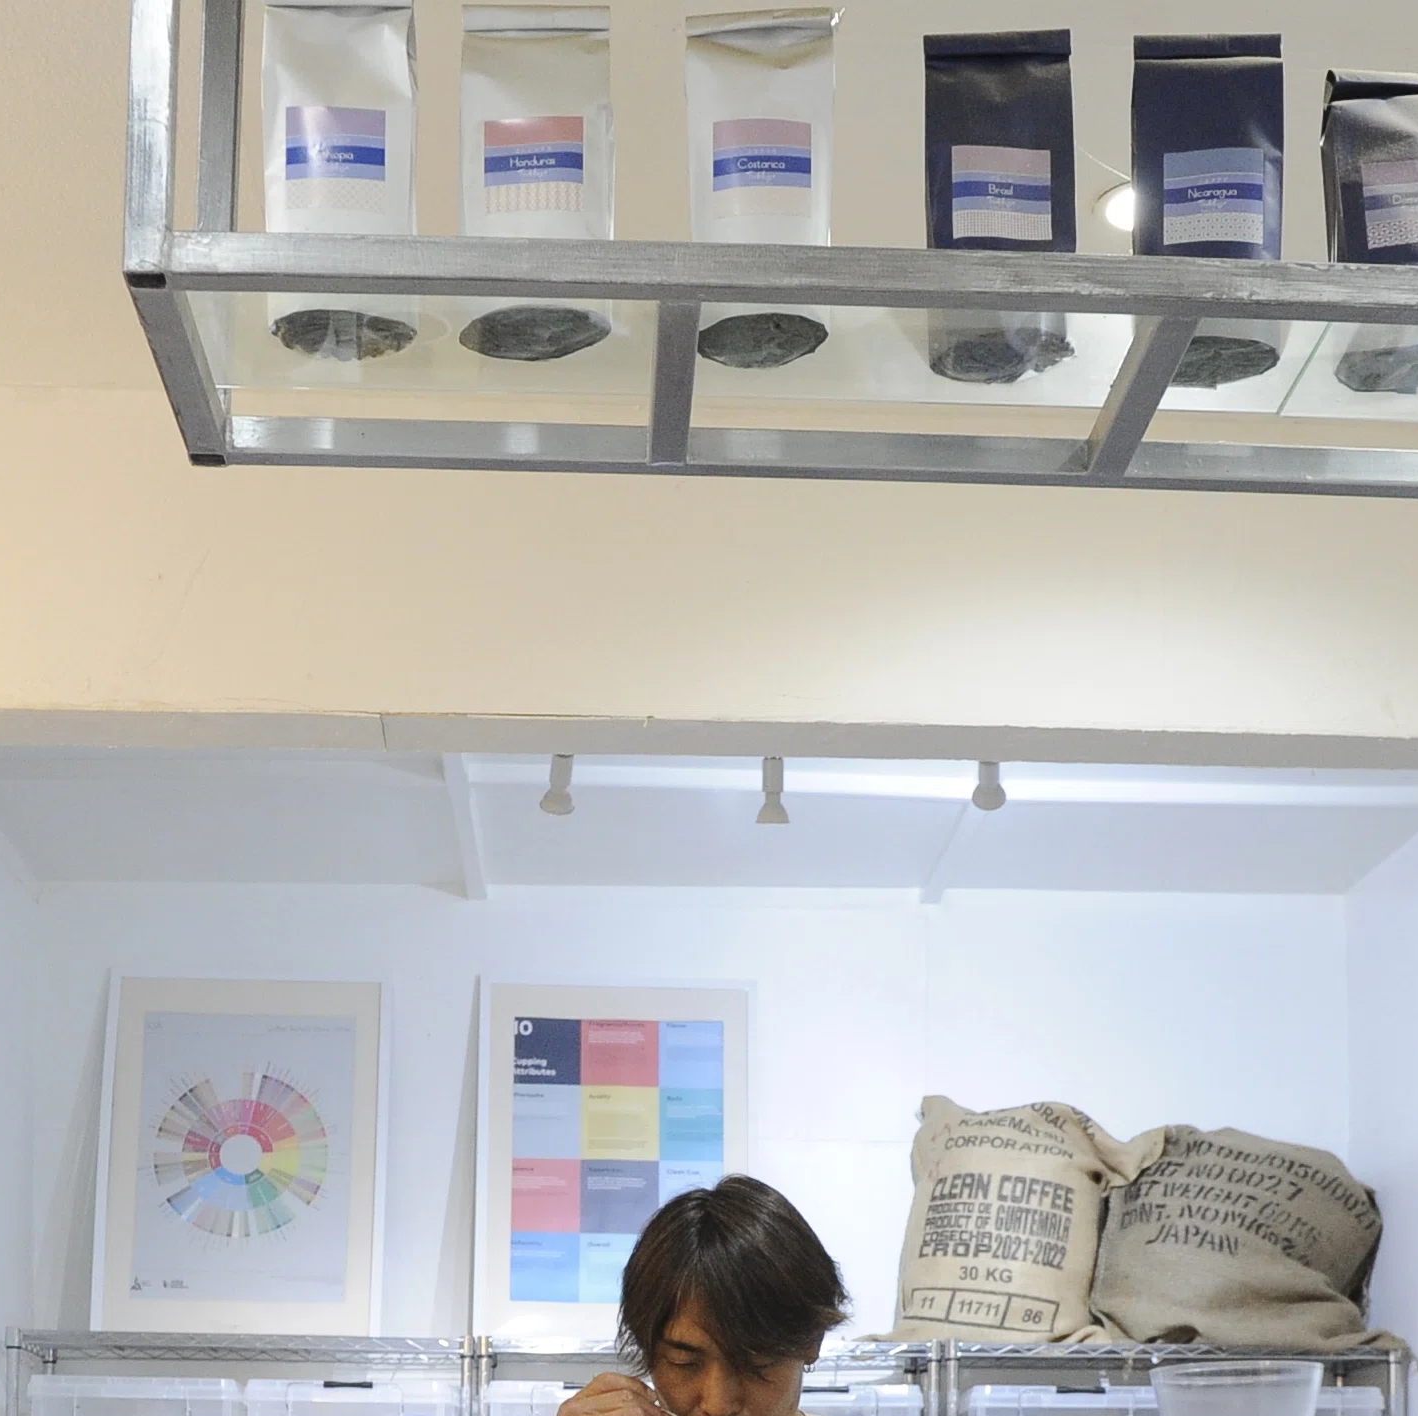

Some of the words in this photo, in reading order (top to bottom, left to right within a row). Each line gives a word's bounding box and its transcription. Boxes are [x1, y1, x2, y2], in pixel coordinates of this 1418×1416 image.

[509, 156, 556, 168] Honduras
[1188, 188, 1238, 199] Nicaragua
[945, 1135, 1074, 1160] CORPORATION
[931, 1173, 992, 1200] CLEAN
[997, 1175, 1075, 1214] COFFEE
[927, 1202, 974, 1214] PRODUCTO
[977, 1203, 992, 1214] DE
[924, 1215, 972, 1230] PRODUCT
[975, 1216, 991, 1229] OF
[995, 1205, 1072, 1243] GUATEMALA
[922, 1230, 993, 1243] COSECHA
[1145, 1224, 1239, 1256] JAPAN
[918, 1242, 992, 1258] CROP
[992, 1233, 1066, 1271] 2021-2022
[959, 1266, 978, 1281] 30
[985, 1268, 1013, 1283] KG
[1022, 1309, 1043, 1324] 86
